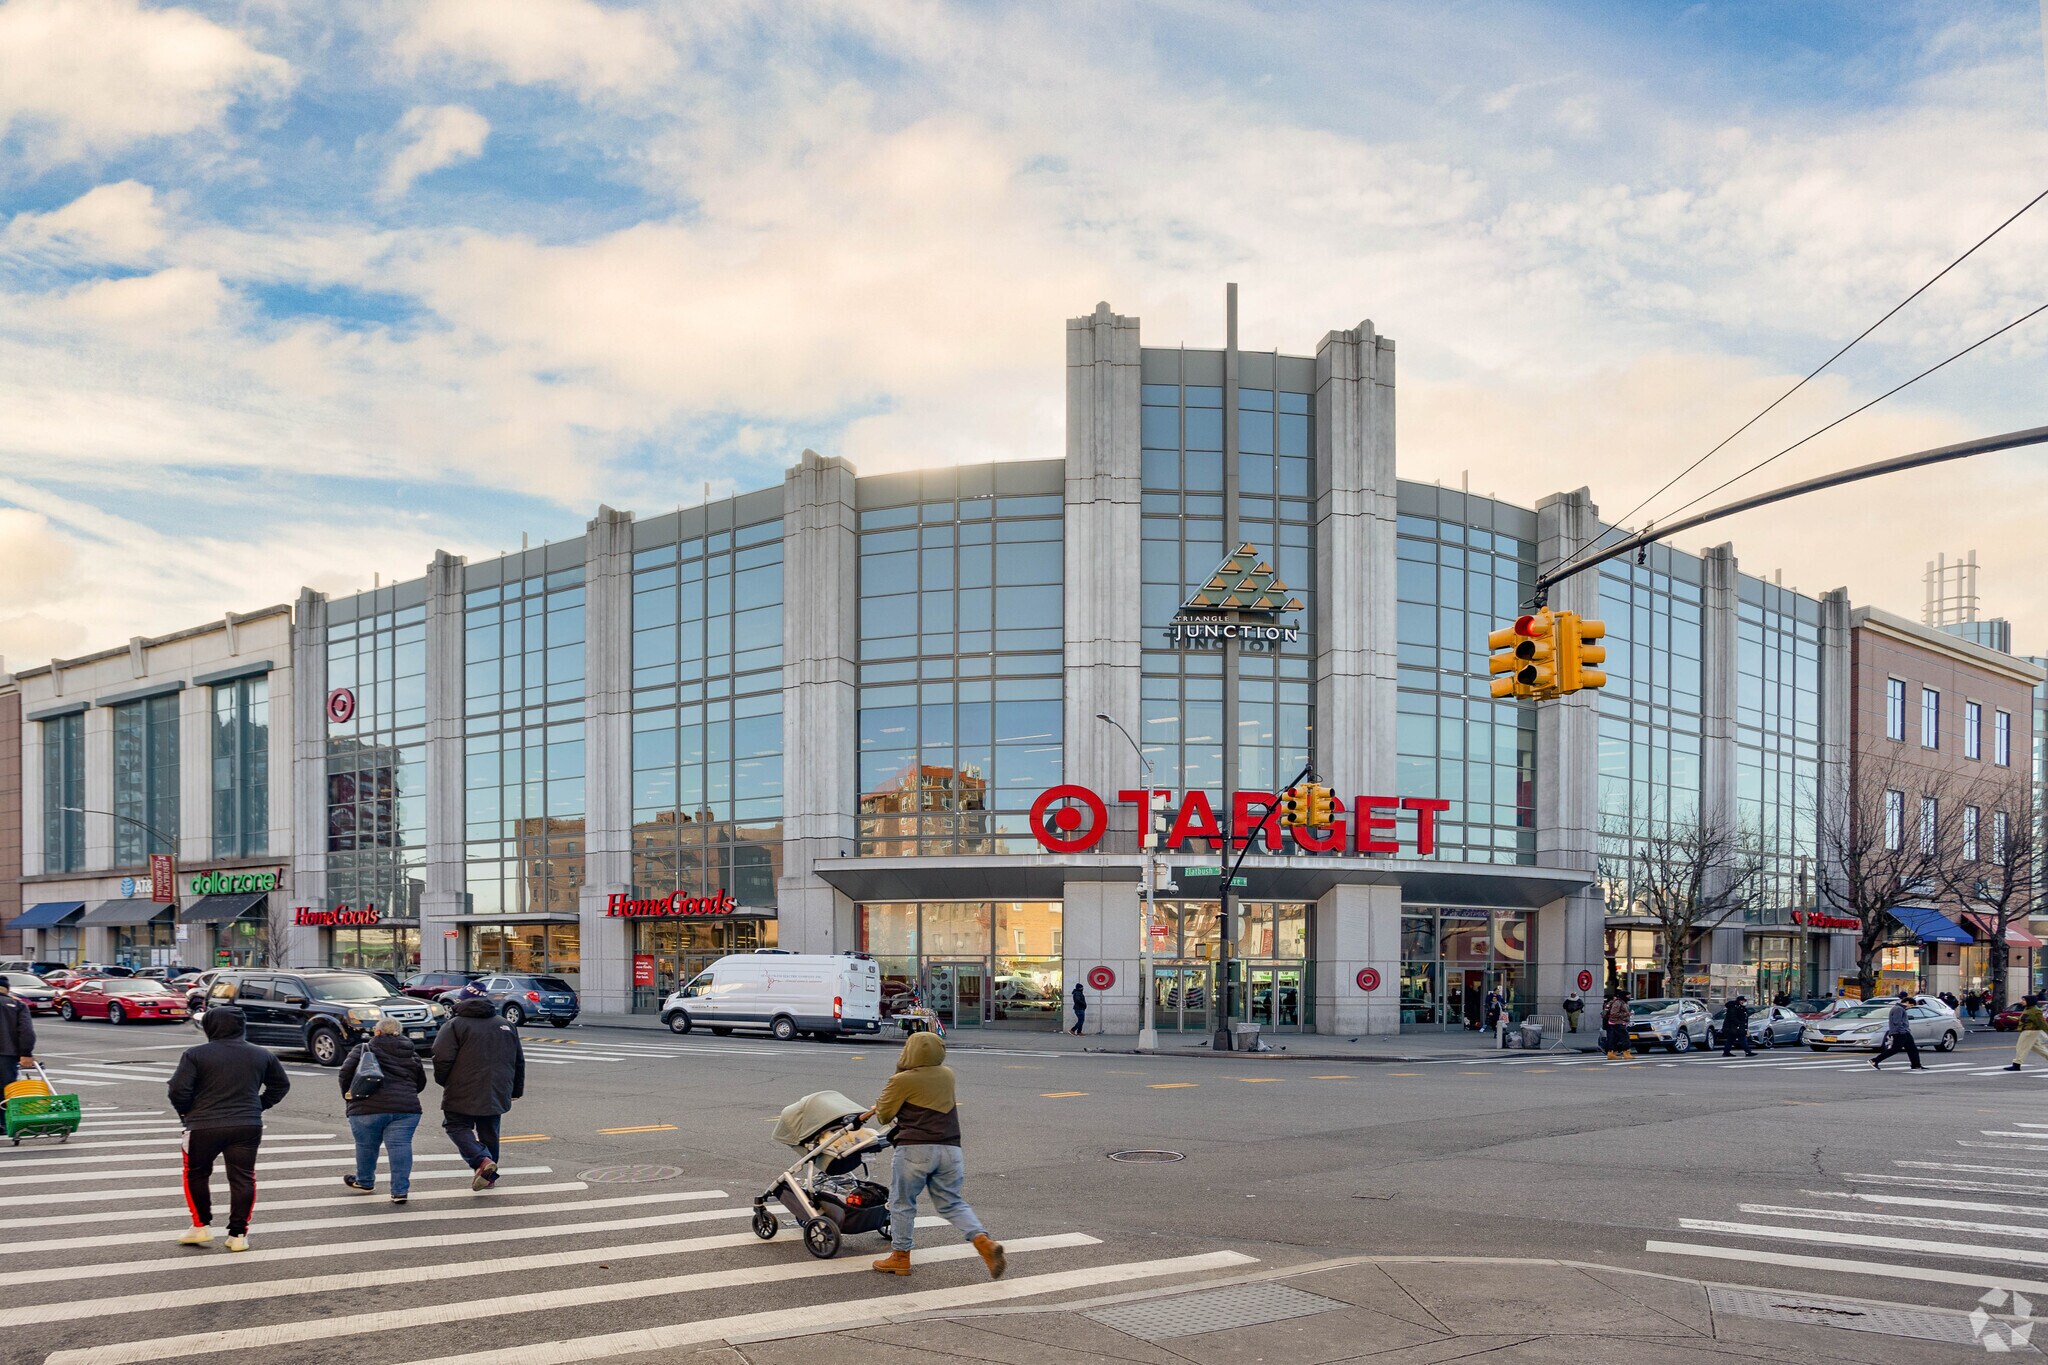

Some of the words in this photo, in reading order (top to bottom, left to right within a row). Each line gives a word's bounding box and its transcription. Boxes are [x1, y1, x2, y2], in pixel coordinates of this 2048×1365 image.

[1175, 624, 1298, 641] JUNCTION
[1118, 790, 1450, 855] TARGET
[155, 860, 162, 869] TO
[155, 870, 163, 896] WINDOW
[162, 861, 171, 896] FLATBUSH
[294, 903, 379, 926] HomeGoods
[606, 888, 735, 917] HomeGoods
